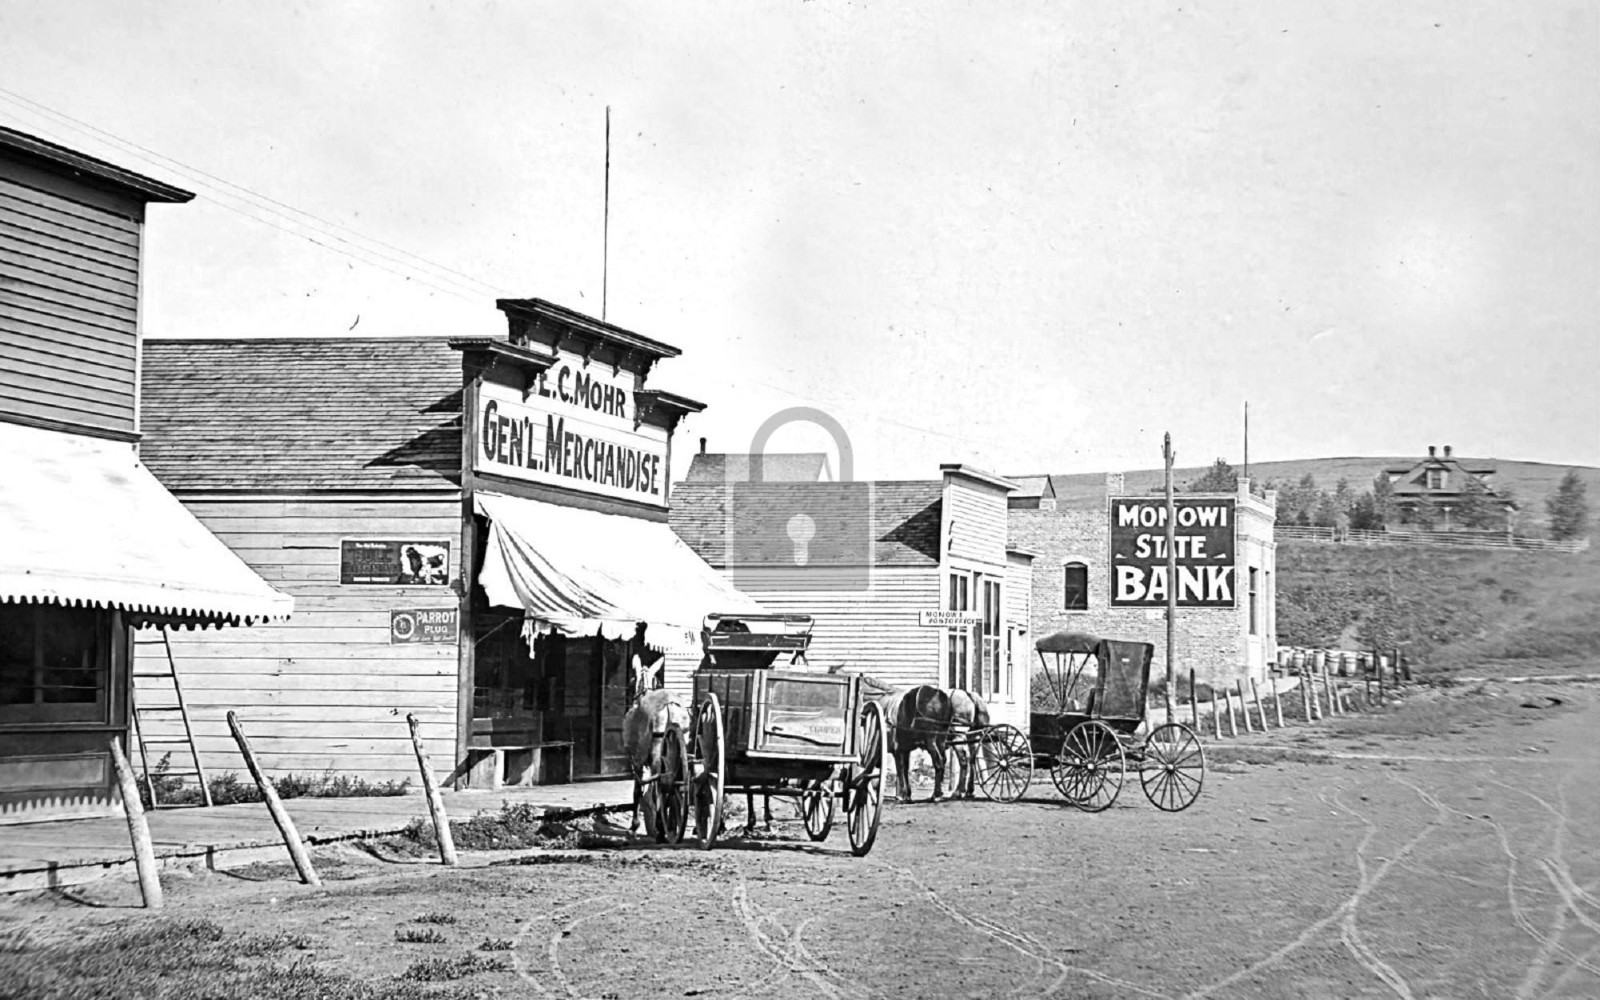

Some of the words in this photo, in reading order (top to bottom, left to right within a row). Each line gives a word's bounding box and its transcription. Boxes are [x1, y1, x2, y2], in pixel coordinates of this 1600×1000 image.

[574, 370, 626, 419] MOHR
[545, 414, 660, 495] MERCHANDISE
[1118, 504, 1227, 527] MONOWI
[1134, 533, 1207, 559] STATE
[1115, 565, 1234, 601] BANK
[416, 611, 455, 626] PARROT
[424, 625, 448, 634] PLUG
